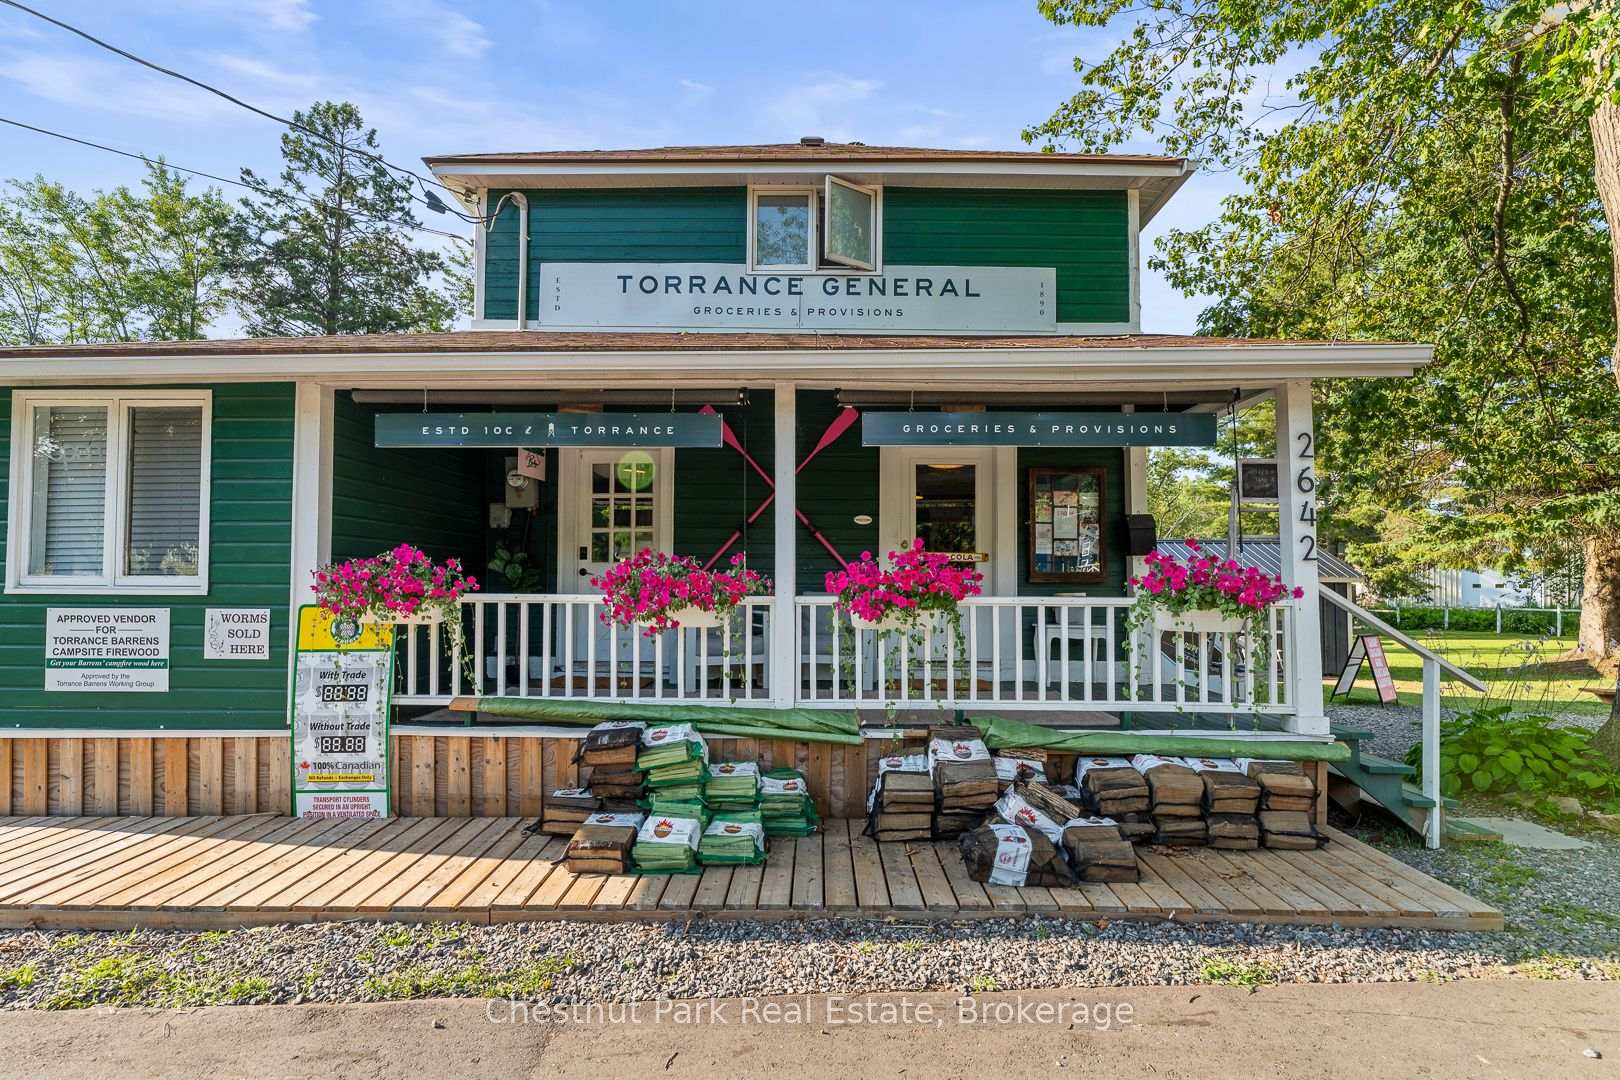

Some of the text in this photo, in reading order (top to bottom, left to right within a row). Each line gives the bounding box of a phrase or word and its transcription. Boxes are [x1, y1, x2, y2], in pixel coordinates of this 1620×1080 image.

[617, 275, 981, 297] TORRANCE GENERAL
[693, 306, 904, 317] GROCERIES & PROVISIONS
[422, 426, 469, 435] ESTD
[571, 426, 674, 435] TORRANCE
[903, 424, 1178, 434] GROCERIES & PROVISIONS
[1297, 432, 1319, 561] 2642
[950, 552, 974, 561] COLA
[57, 615, 156, 624] APPROVED VENDOR
[221, 613, 268, 623] WORMS
[96, 626, 117, 634] FOR
[227, 629, 261, 638] SOLD
[53, 637, 159, 645] TORRANCE BARRENS
[52, 648, 160, 656] CAMPSITE FIREWOOD
[230, 644, 265, 654] HERE
[61, 660, 76, 668] your
[105, 659, 131, 668] campfire
[341, 670, 367, 679] Trade
[310, 722, 370, 731] Without Trade
[313, 761, 381, 769] 100% Canadian
